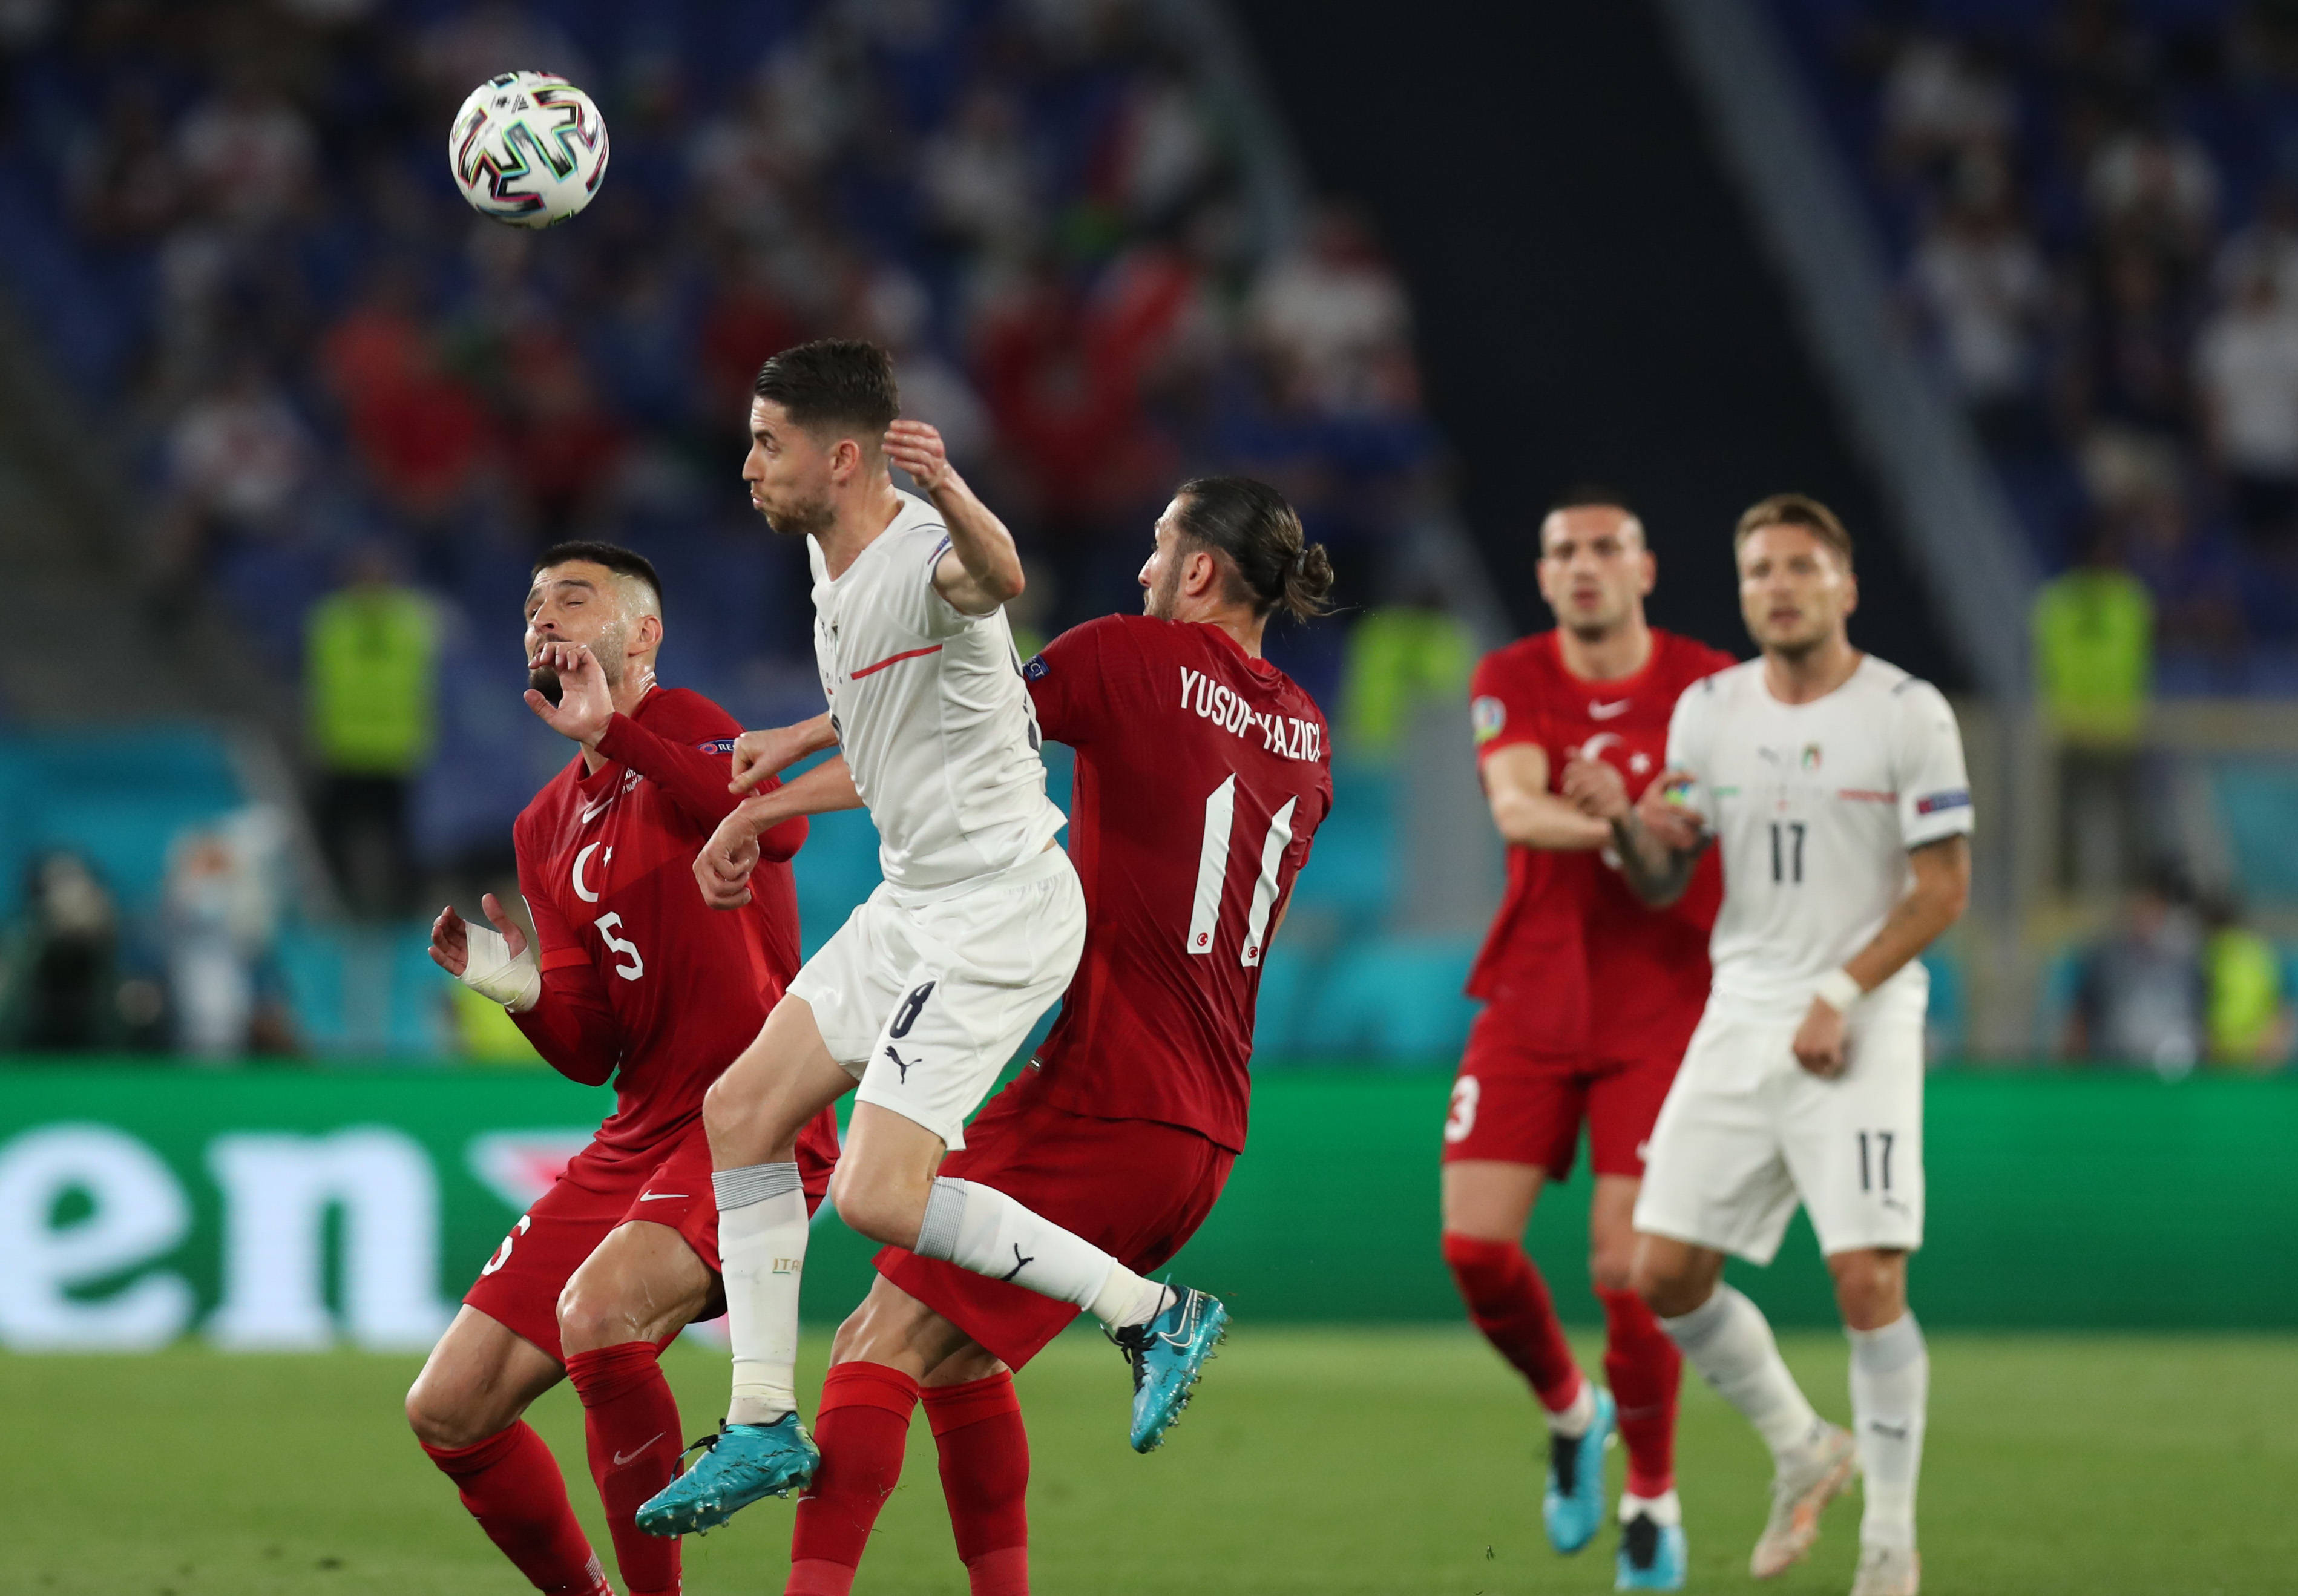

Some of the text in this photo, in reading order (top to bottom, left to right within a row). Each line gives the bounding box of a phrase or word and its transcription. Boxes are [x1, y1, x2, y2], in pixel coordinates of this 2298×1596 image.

[1180, 666, 1256, 738] YUSUF
[1187, 772, 1299, 967] 11
[1769, 822, 1805, 882] 17
[593, 911, 643, 981] 5
[890, 980, 936, 1039] 8
[1444, 1074, 1480, 1143] 3
[1858, 1131, 1894, 1190] 17
